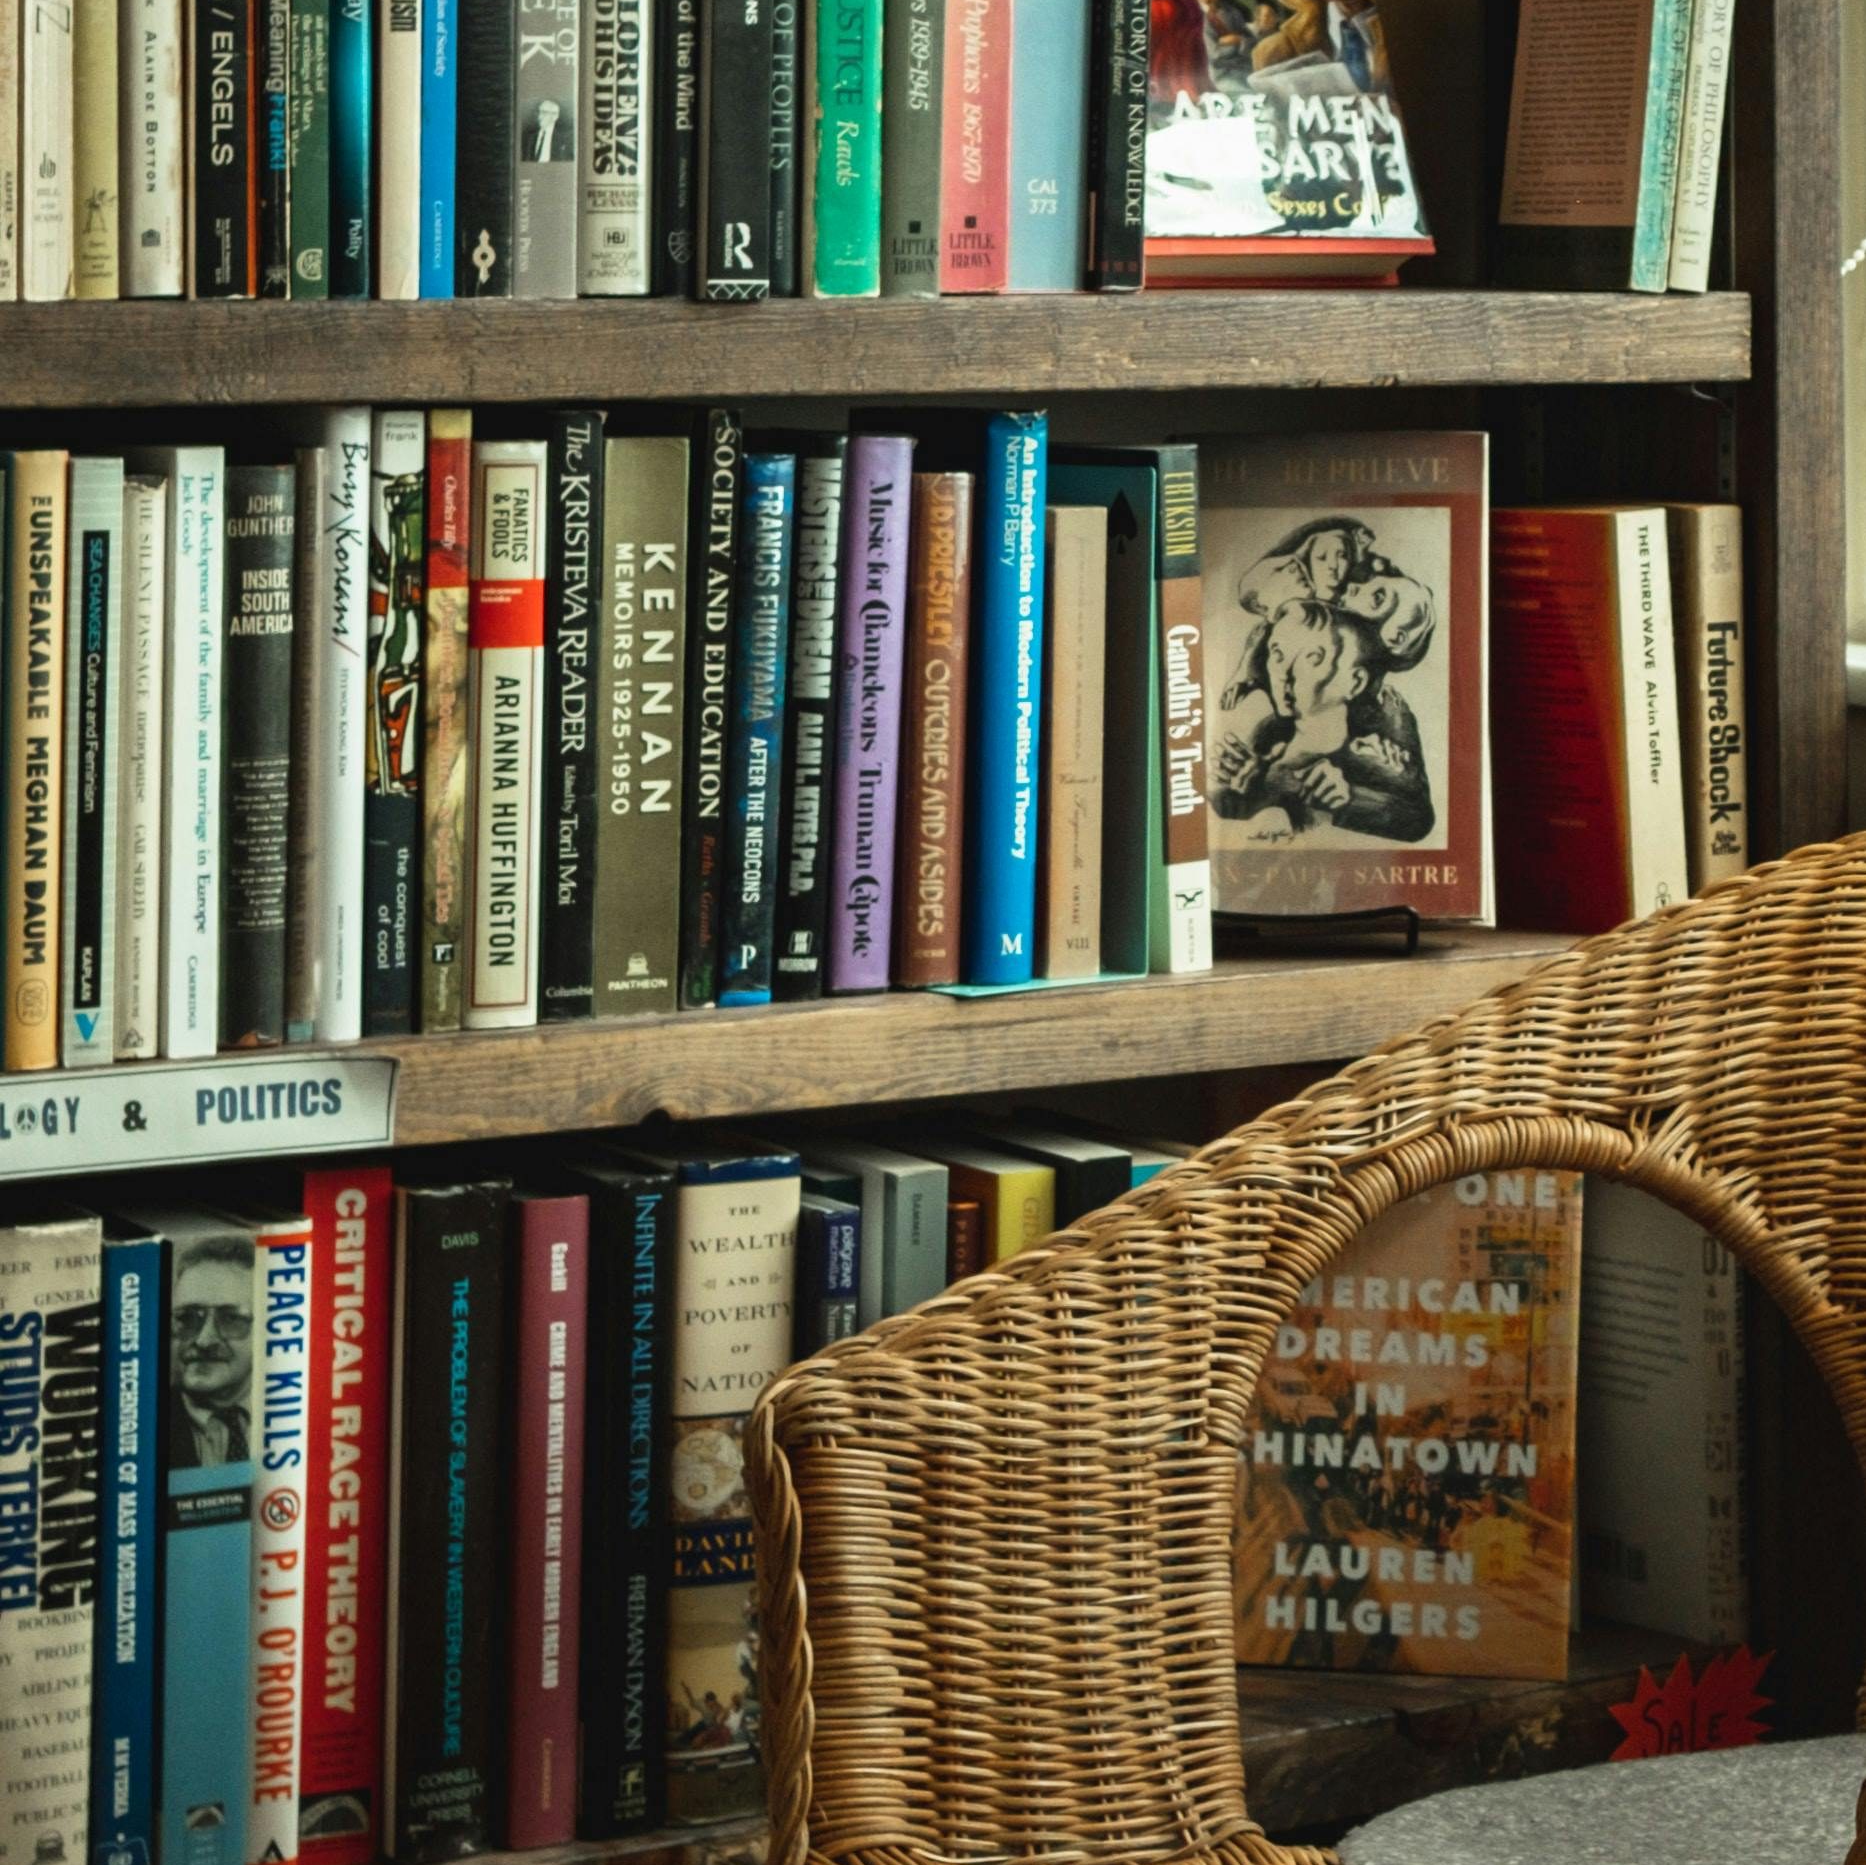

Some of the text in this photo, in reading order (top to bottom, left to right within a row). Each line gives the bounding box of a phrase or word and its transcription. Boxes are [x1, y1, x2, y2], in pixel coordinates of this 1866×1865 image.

[557, 28, 579, 67] OF
[210, 31, 234, 167] ENGELS
[835, 120, 859, 187] Rawls
[228, 517, 295, 537] GUNTHER
[246, 495, 283, 514] JOHN
[26, 496, 52, 720] THE UNSPEAKABLE
[240, 592, 290, 613] SOUTH
[242, 569, 290, 588] INSIDE
[560, 422, 590, 756] The KRISTEVA READER
[747, 485, 785, 722] FRANCIS FUKUYAMA
[229, 614, 295, 636] AMERICA
[860, 479, 895, 753] Music for Chameleons
[611, 543, 635, 816] MEMOIRS 1925-1950
[640, 542, 677, 815] KENNAN
[1707, 620, 1741, 824] Future Shock
[1169, 742, 1205, 817] Truth
[488, 675, 519, 968] ARIANNA HUFFINGTON
[743, 736, 768, 904] AFTER THE NEOCONS
[22, 736, 51, 967] MEGHAN DAUM
[846, 762, 884, 959] Truman Capote
[607, 977, 669, 991] PANTHEON
[122, 1099, 147, 1133] &
[195, 1078, 342, 1127] POLITICS
[728, 1205, 762, 1217] THE
[1456, 1173, 1558, 1207] ONE
[689, 1233, 795, 1254] WEALTH
[728, 1276, 762, 1287] AND
[685, 1300, 793, 1325] POVERTY
[263, 1243, 306, 1471] PEACE KILLS
[1277, 1326, 1489, 1368] DREAMS
[1354, 1382, 1406, 1417] IN
[40, 1305, 101, 1611] WORKING
[324, 1188, 368, 1715] CRITICAL RACE THEORY
[1254, 1432, 1537, 1478] HINATOWN
[1274, 1542, 1476, 1586] LAUREN
[1265, 1597, 1481, 1640] HILGERS
[254, 1551, 299, 1806] P.J. O'ROURKE
